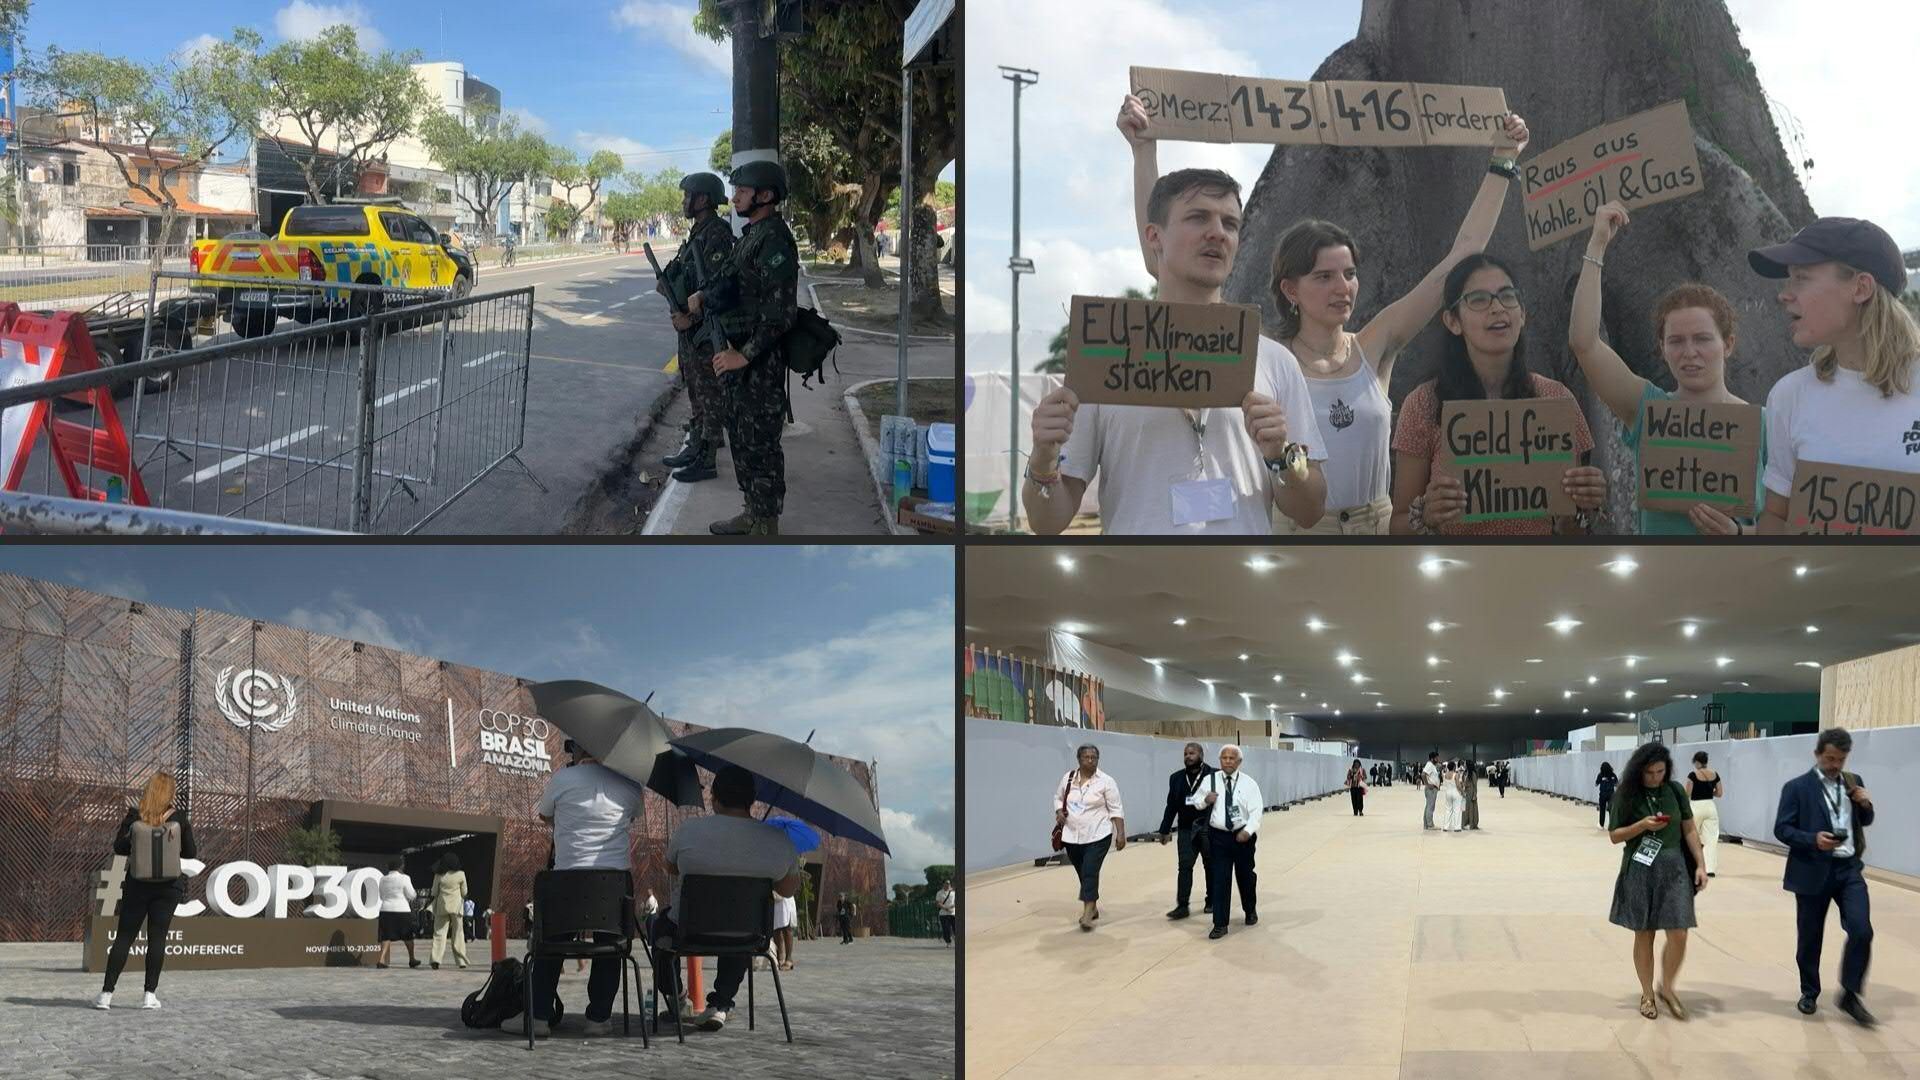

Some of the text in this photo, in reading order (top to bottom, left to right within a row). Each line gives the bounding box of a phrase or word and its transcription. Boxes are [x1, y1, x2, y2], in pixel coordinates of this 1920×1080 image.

[1525, 132, 1638, 194] Raus aus
[1527, 198, 1583, 241] Kohle,
[1583, 175, 1607, 216] Öl
[1082, 301, 1246, 355] EU-Klimaziel
[1103, 347, 1212, 393] stärken
[1447, 408, 1573, 465] Geld fürs
[1647, 405, 1739, 440] Wälder
[1463, 468, 1549, 515] Klima
[1644, 456, 1739, 494] retten
[1843, 480, 1916, 530] GRAD
[329, 696, 421, 724] United Nations
[330, 716, 422, 744] Climate Change
[481, 729, 552, 760] BRASIL
[164, 944, 244, 956] CONFERENCE
[305, 945, 346, 953] NOVEMBER
